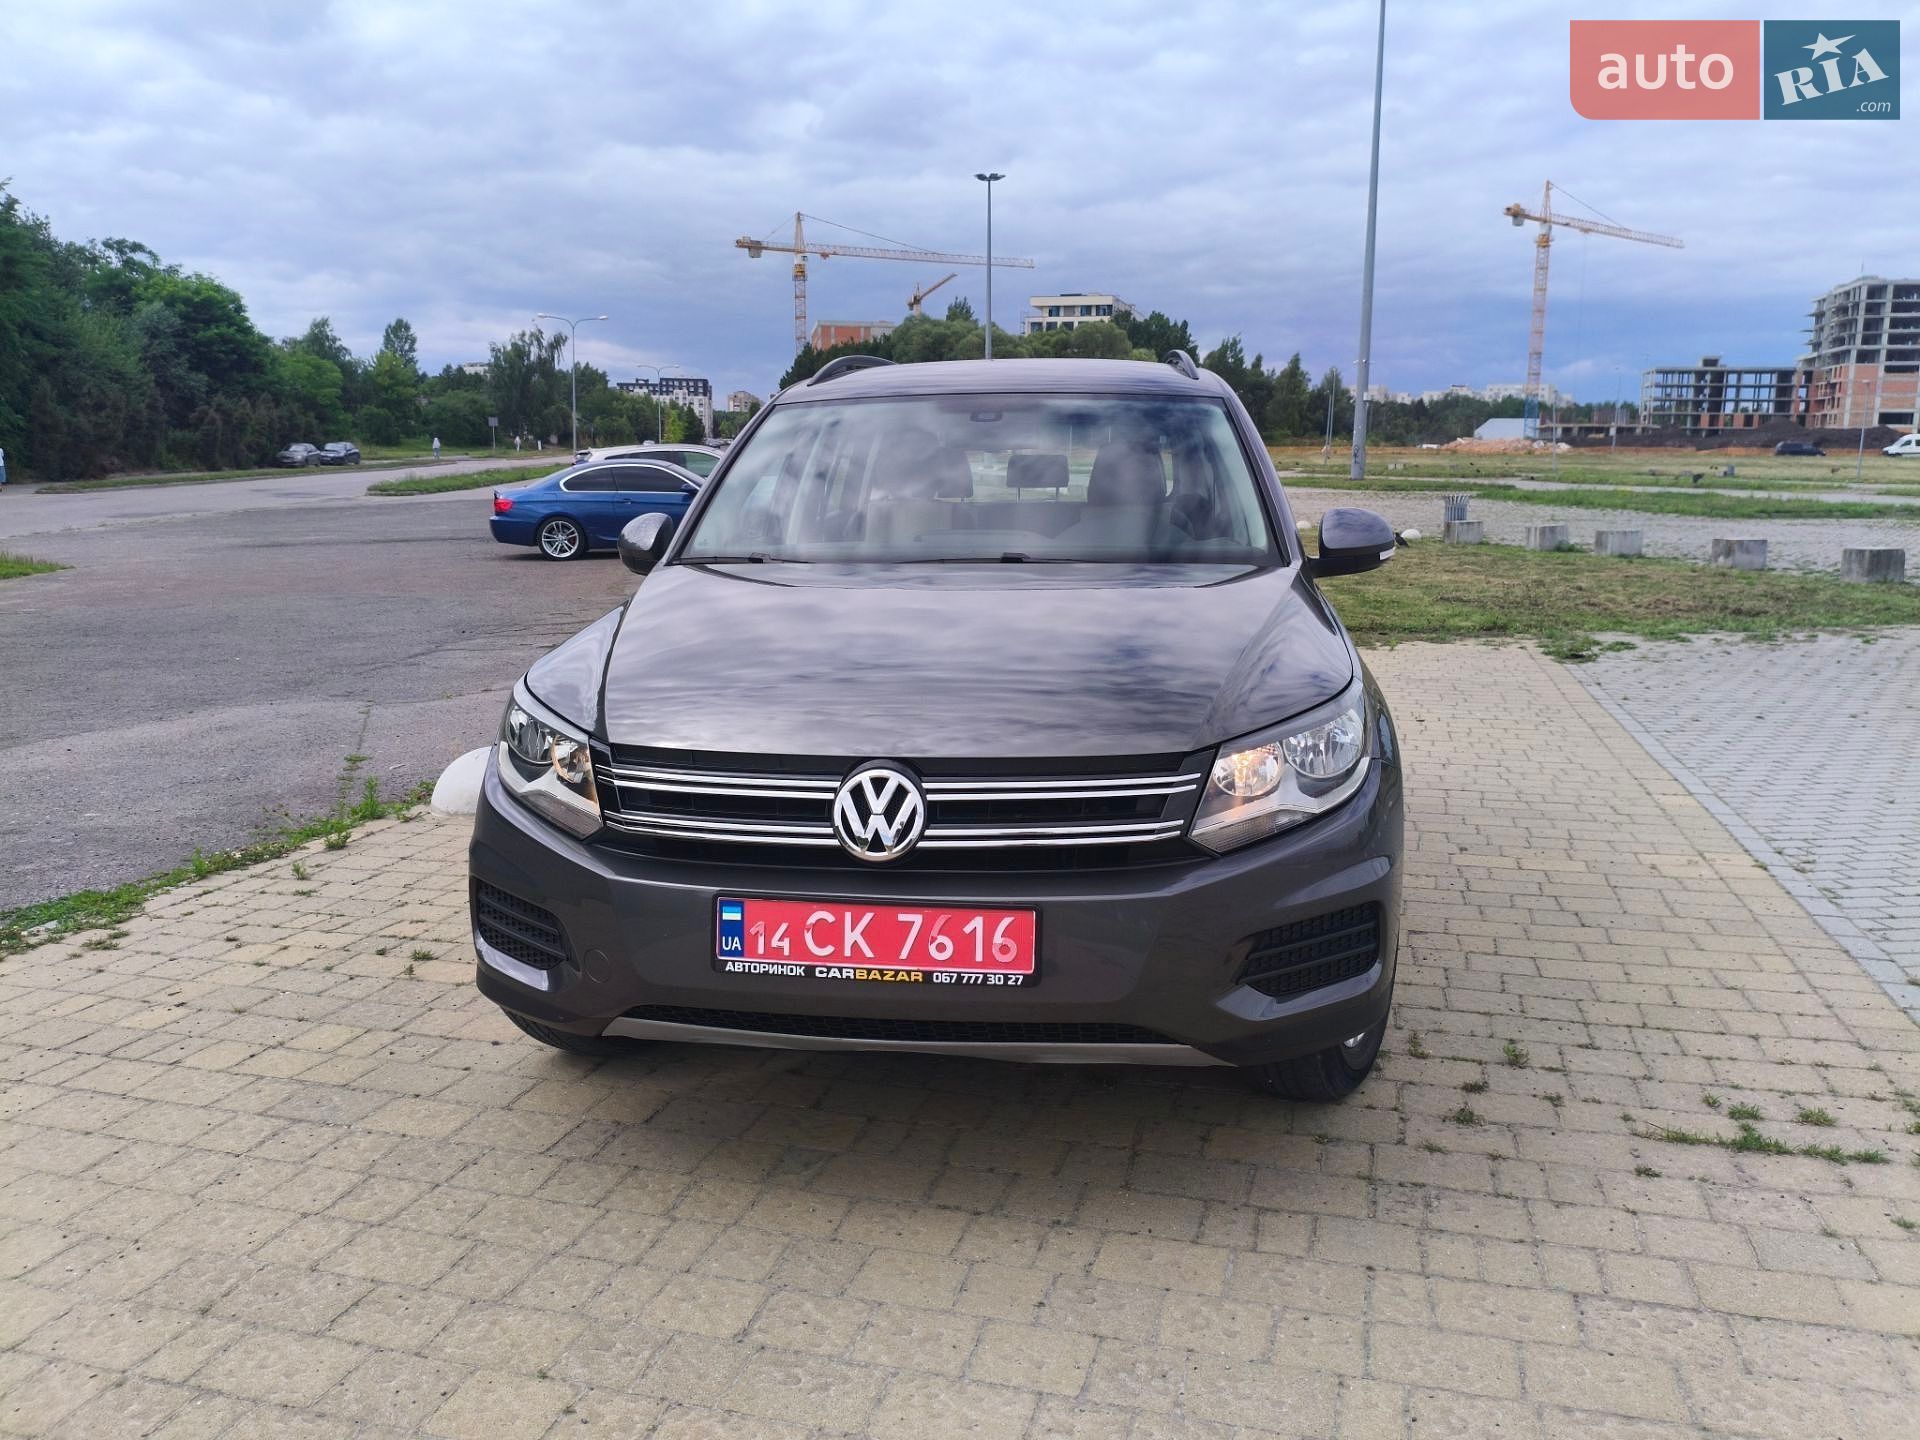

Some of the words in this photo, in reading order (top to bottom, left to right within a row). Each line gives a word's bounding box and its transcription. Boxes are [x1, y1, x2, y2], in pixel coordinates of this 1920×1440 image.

[722, 936, 742, 951] UA
[749, 920, 790, 956] 14
[804, 910, 875, 958] CK
[897, 913, 1018, 963] 7616
[725, 961, 805, 977] АВТОРИНОК
[815, 967, 923, 982] CARBAZAR
[932, 972, 957, 984] 067
[961, 973, 983, 985] 777
[987, 974, 1004, 985] 30
[1007, 975, 1024, 986] 27
